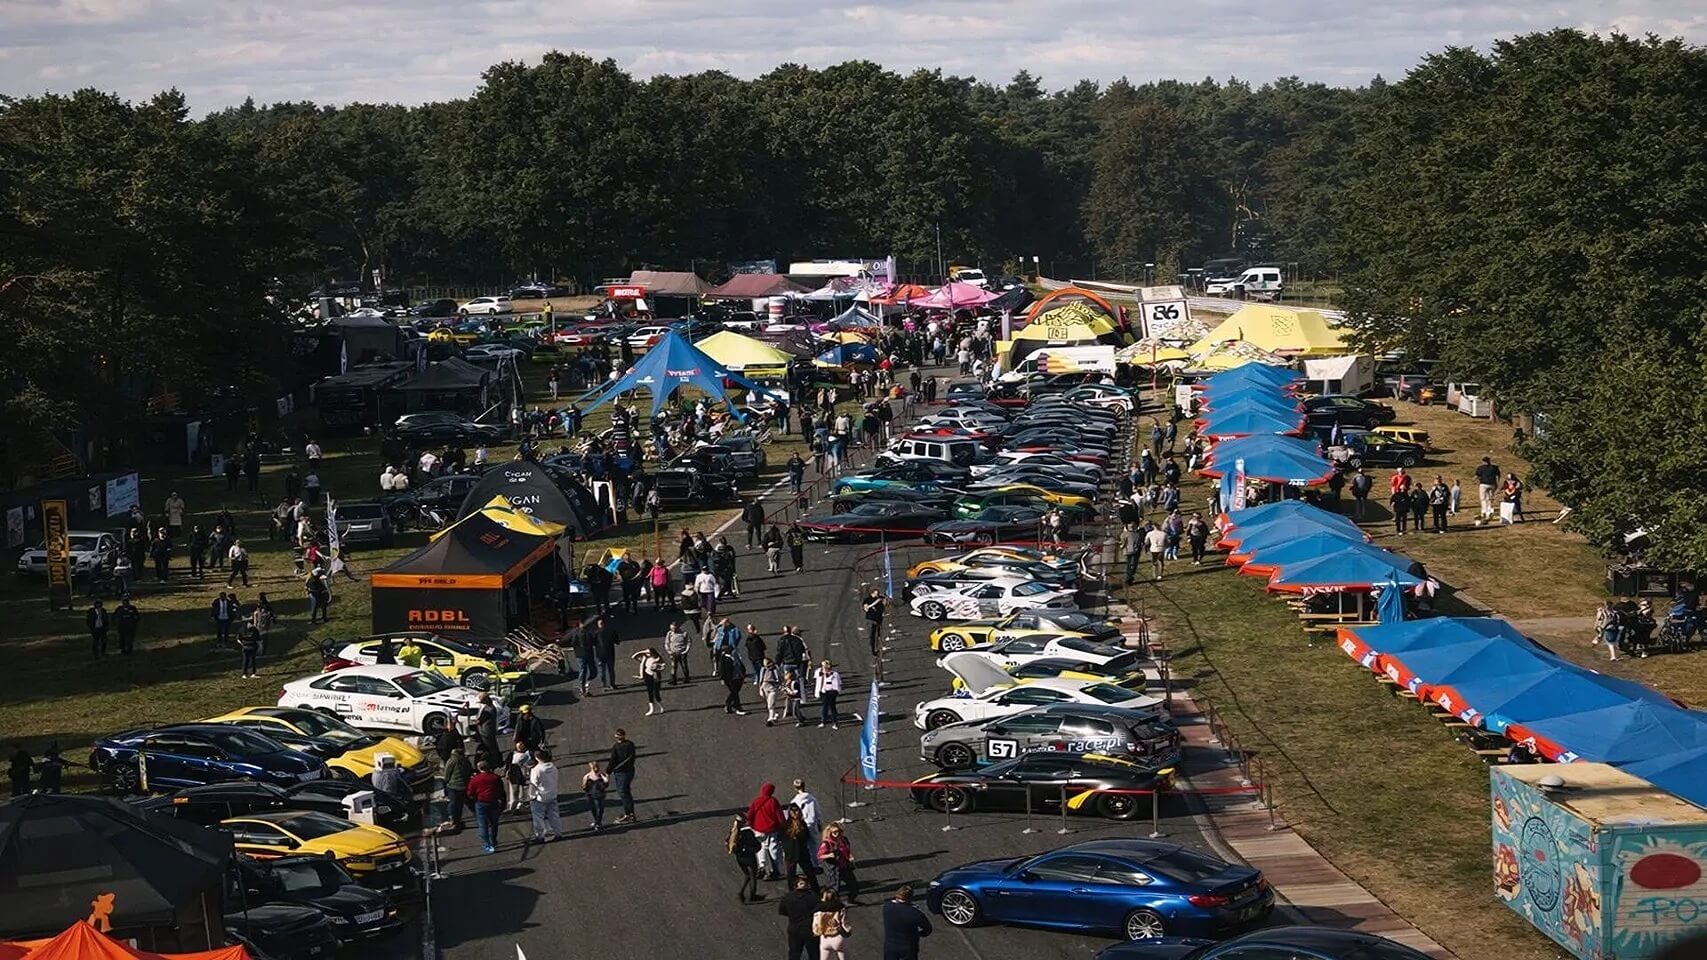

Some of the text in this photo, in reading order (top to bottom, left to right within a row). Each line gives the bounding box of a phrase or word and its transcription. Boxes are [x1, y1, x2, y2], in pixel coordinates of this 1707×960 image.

[504, 495, 540, 506] YGAN
[408, 609, 470, 622] ADBL
[993, 742, 1014, 756] 57
